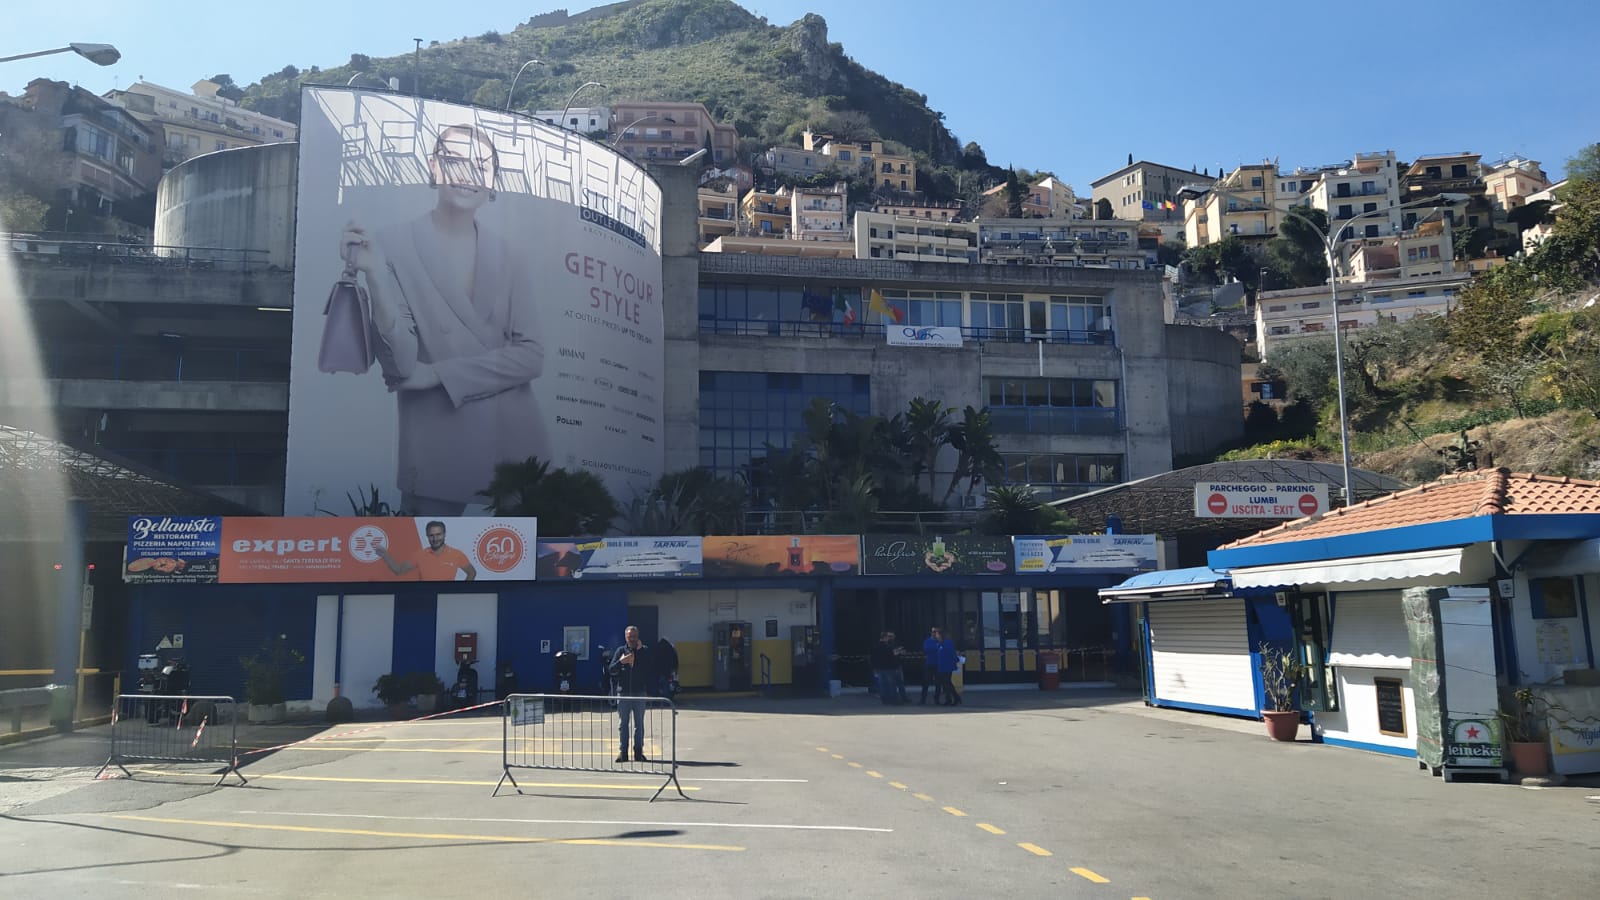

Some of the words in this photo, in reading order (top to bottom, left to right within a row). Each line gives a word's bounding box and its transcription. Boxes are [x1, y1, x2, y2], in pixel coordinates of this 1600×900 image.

[582, 209, 618, 229] OUTLET
[619, 224, 645, 246] VILLAGE
[565, 252, 607, 282] GET
[613, 266, 653, 305] YOUR
[590, 287, 640, 325] STYLE
[564, 310, 574, 319] AT
[575, 312, 600, 325] OUTLET
[1209, 484, 1267, 493] PARCHEGGIO
[1276, 485, 1316, 493] PARKING
[1249, 496, 1278, 504] LUMBI
[1231, 505, 1266, 515] USCITA
[1273, 505, 1295, 515] EXIT
[132, 517, 217, 540] Bellavista
[232, 536, 342, 555] expert
[486, 536, 515, 554] 60
